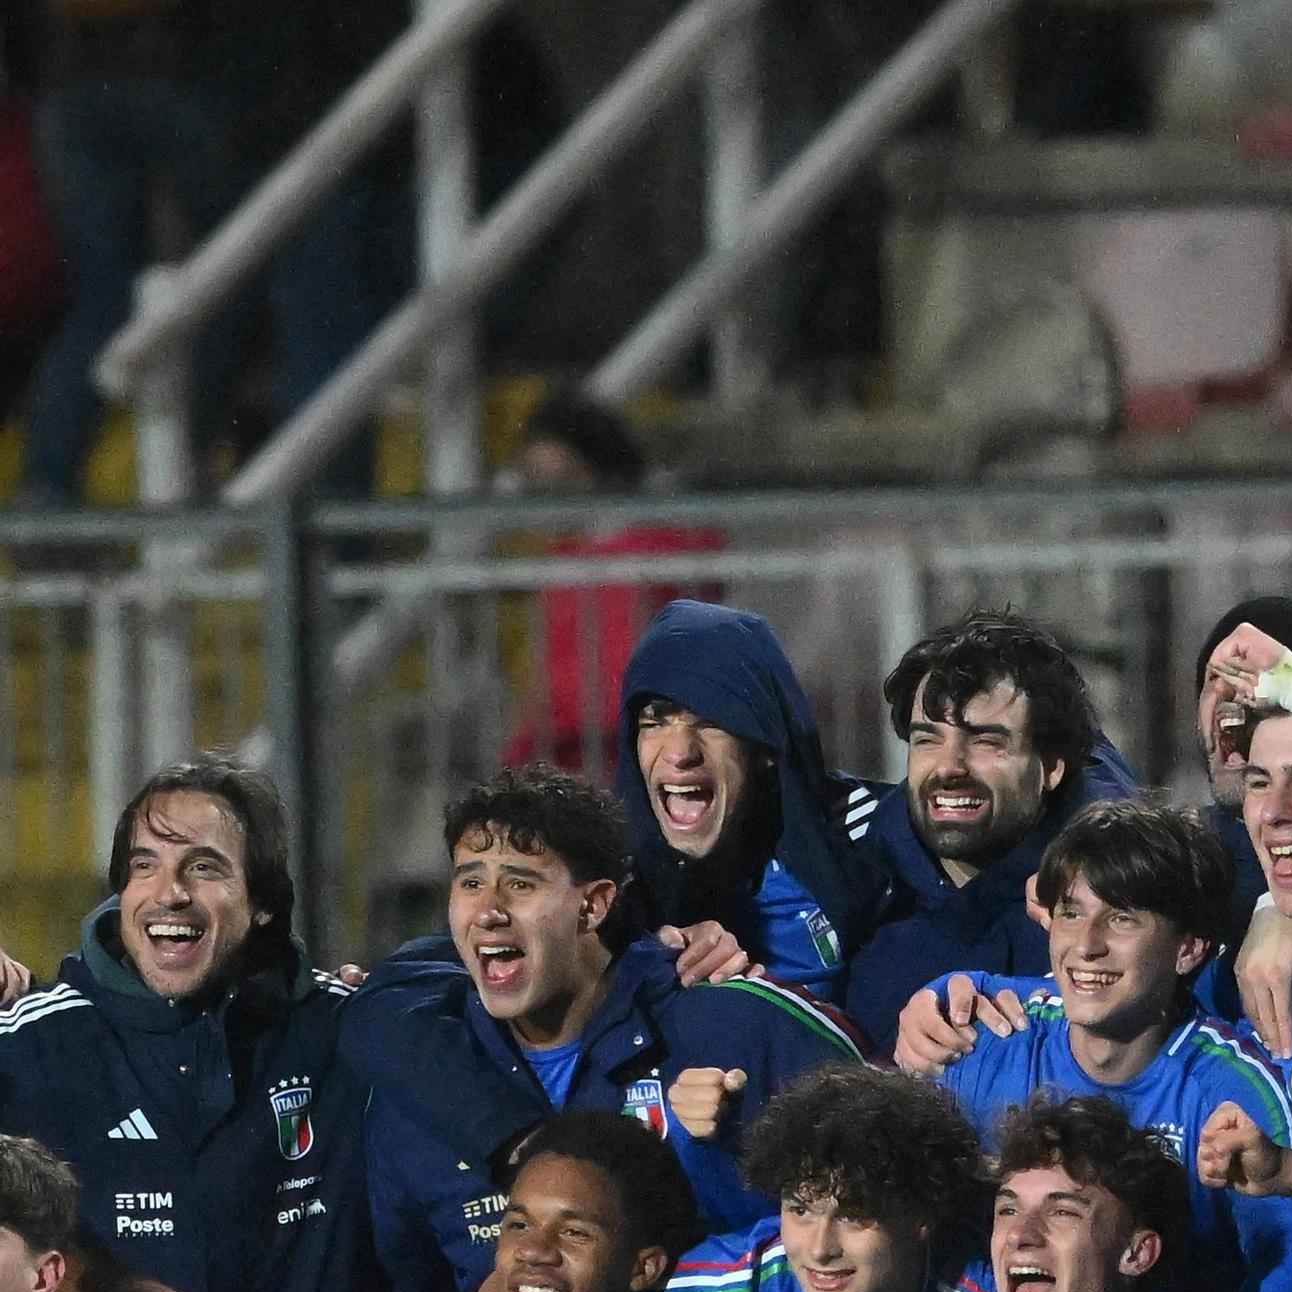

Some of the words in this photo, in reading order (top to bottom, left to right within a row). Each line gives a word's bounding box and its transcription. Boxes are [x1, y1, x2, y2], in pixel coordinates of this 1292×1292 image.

[626, 1085, 658, 1102] TALIA
[275, 1093, 309, 1113] ITALIA
[136, 1192, 173, 1209] TIM
[277, 1203, 304, 1225] eni
[116, 1216, 174, 1233] Poste
[468, 1221, 504, 1241] Pos
